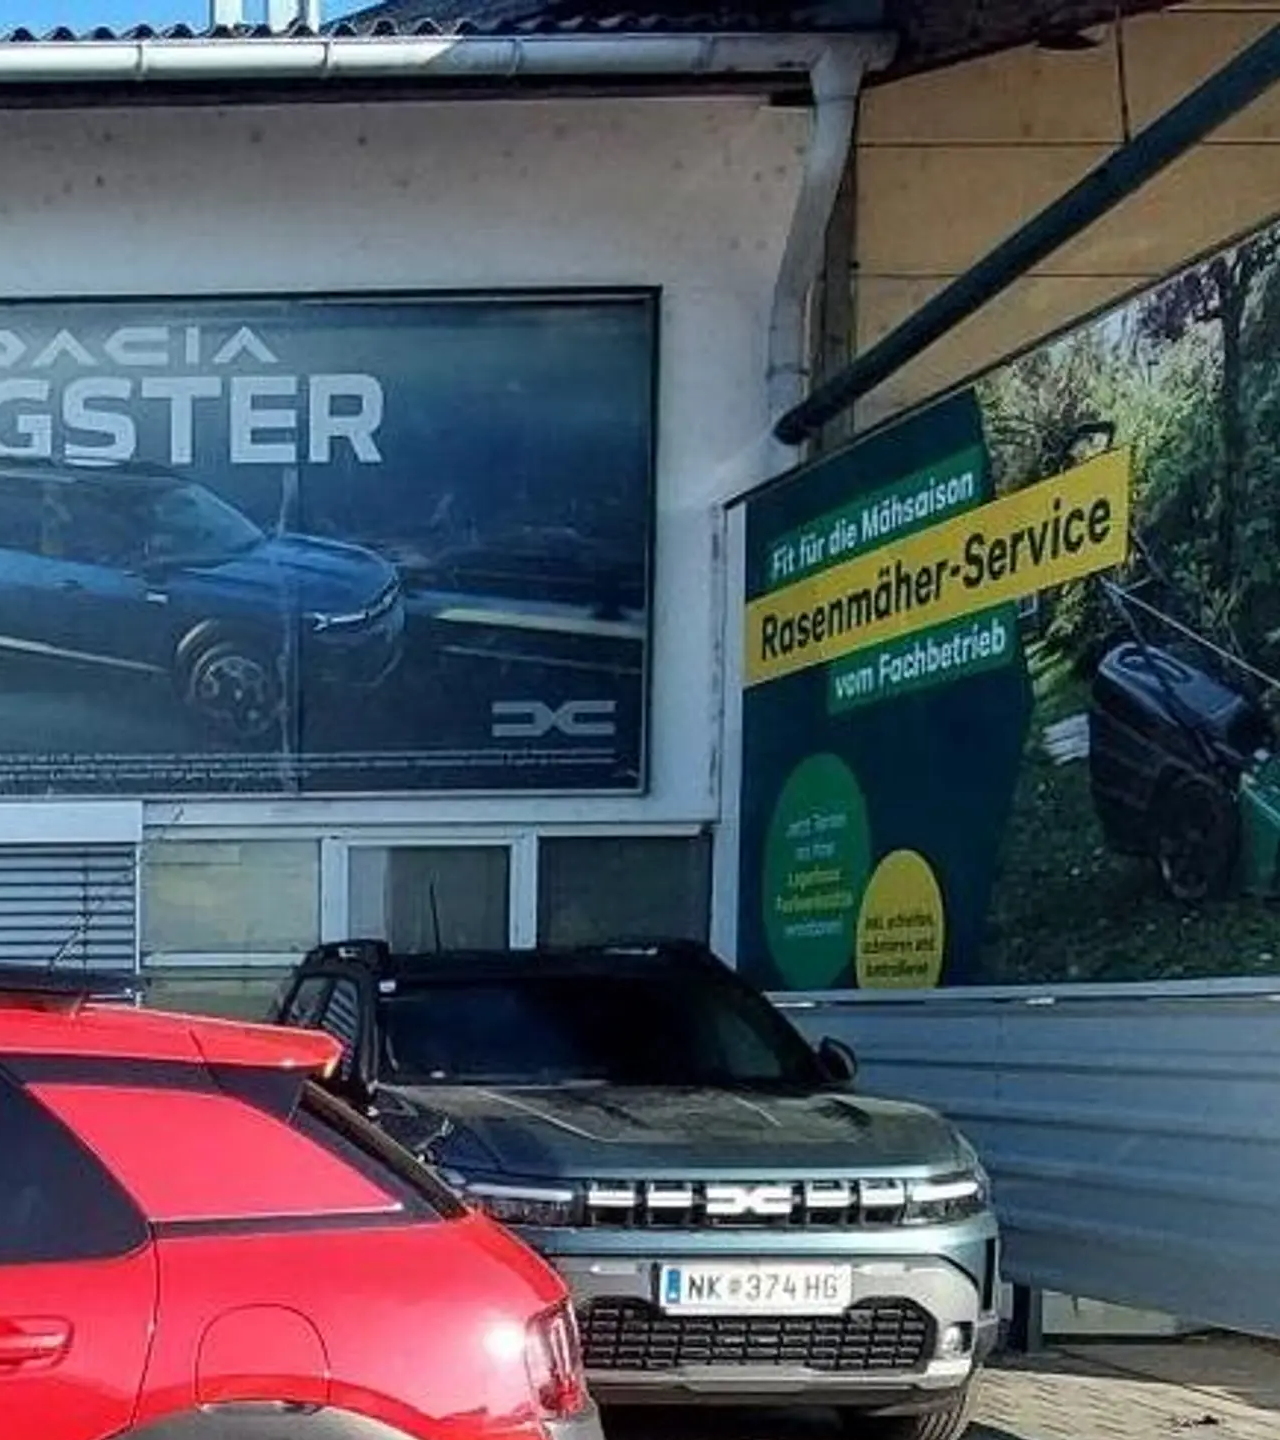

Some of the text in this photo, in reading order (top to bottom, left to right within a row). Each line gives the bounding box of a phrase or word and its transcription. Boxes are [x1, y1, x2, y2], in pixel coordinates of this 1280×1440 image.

[772, 470, 975, 579] Fit für die Mähsaison
[760, 496, 1111, 662] Rasenmäher-Service
[835, 618, 1007, 699] vom Fachbetrieb
[688, 1273, 838, 1300] NK 374 HG
